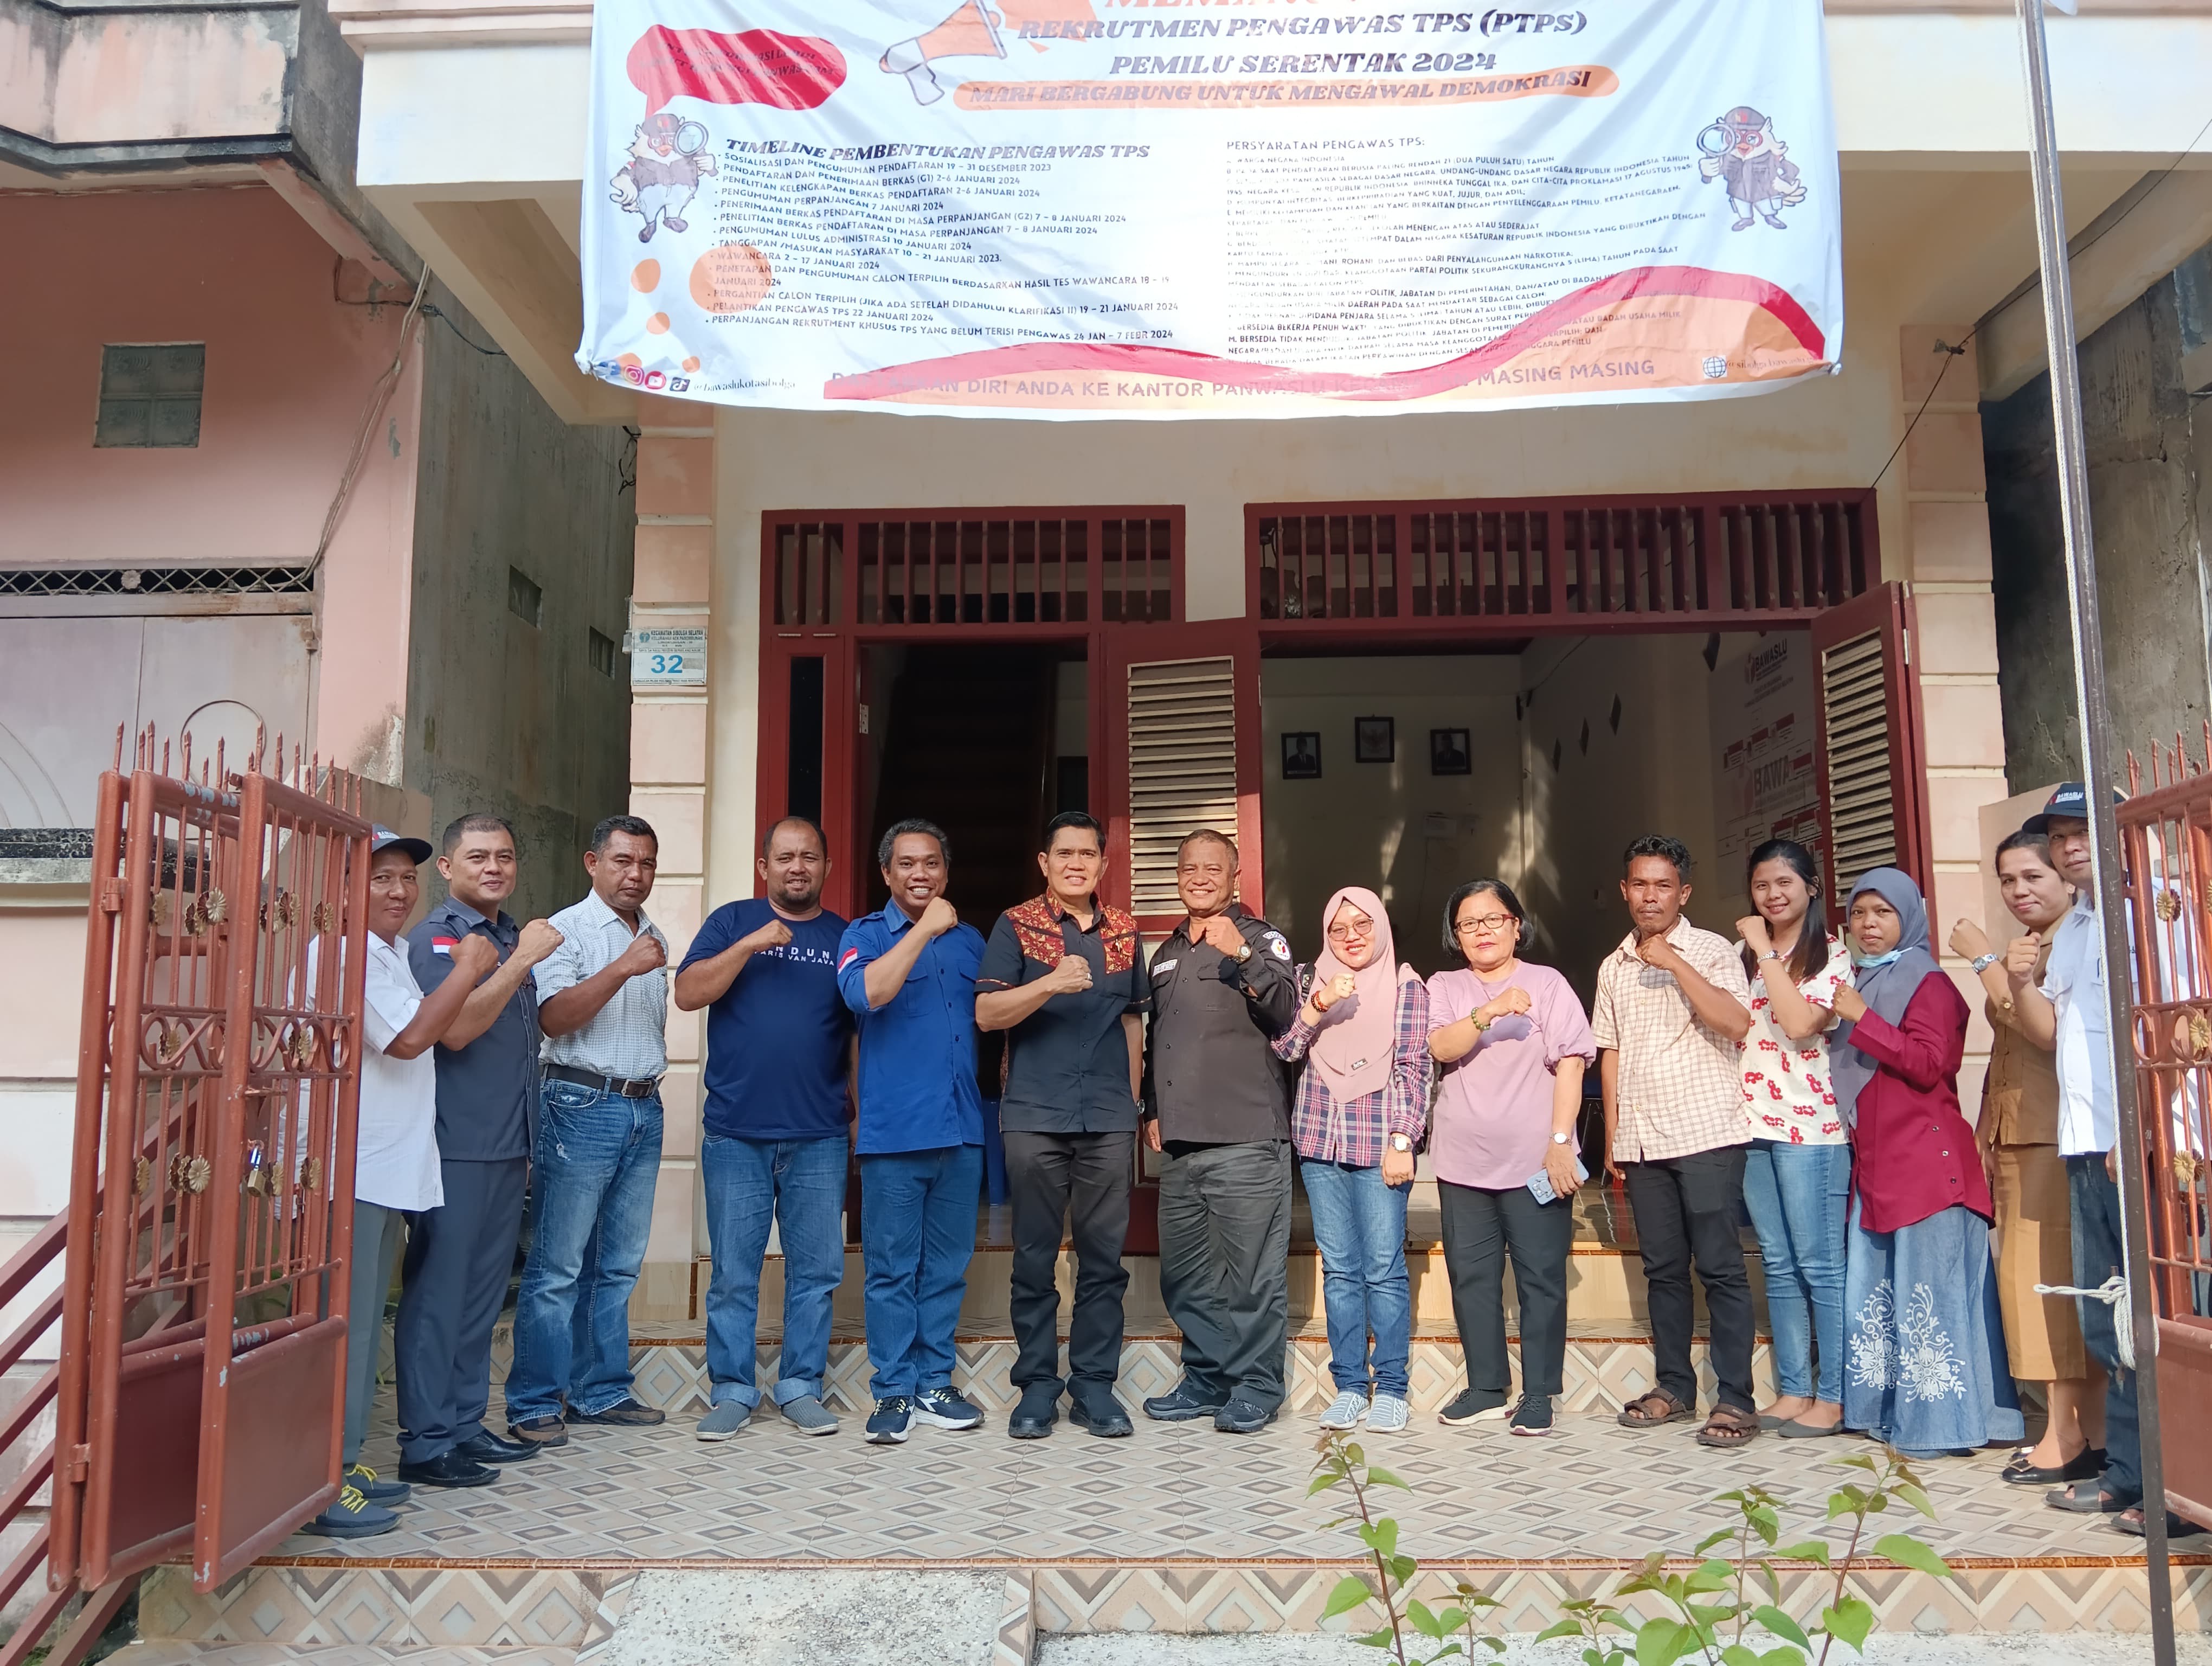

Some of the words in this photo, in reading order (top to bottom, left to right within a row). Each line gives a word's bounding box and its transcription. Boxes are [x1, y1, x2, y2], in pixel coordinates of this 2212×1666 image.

[1018, 18, 1222, 40] REKRUTMEN
[1226, 13, 1405, 37] PENGAWAS
[1412, 12, 1474, 33] TPS
[1480, 8, 1587, 37] (PTPS)
[1110, 55, 1233, 74] PEMILU
[1239, 52, 1409, 74] SERENTAK
[1412, 52, 1497, 73] 2024
[970, 86, 1038, 103] MARI
[1039, 85, 1193, 102] BERGABUNG
[1197, 85, 1285, 101] UNTUK
[1289, 83, 1435, 101] MENGAWAL
[1438, 69, 1592, 98] DEMOKRASI
[726, 139, 826, 158] TIMELINE
[829, 144, 986, 161] PEMBENTUKAN
[988, 145, 1105, 158] PENGAWAS
[1111, 145, 1150, 157] TPS
[1227, 141, 1317, 150] PERSYARATAN
[1323, 139, 1394, 149] PENGAWAS
[1399, 137, 1425, 146] TPS:
[725, 153, 781, 166] SOSIALISASI
[808, 159, 875, 174] PENGUMUMAN
[878, 162, 943, 172] PENDAFTARAN
[1544, 165, 1573, 174] NEGARA
[1614, 158, 1659, 173] INDONESIA
[724, 164, 792, 179] PENDAFTARAN
[819, 172, 879, 186] PENERIMAAN
[883, 175, 915, 186] BERKAS
[917, 175, 933, 184] (G1)
[955, 175, 995, 183] JANUARI
[1571, 176, 1622, 185] PROKLAMASI
[1635, 167, 1671, 177] AGUSTUS
[723, 176, 776, 190] PENELITIAN
[780, 183, 846, 193] KELENGKAPAN
[850, 189, 884, 198] BERKAS
[888, 188, 953, 199] PENDAFTARAN
[722, 188, 790, 203] PENGUMUMAN
[795, 196, 869, 208] PERPANJANGAN
[880, 203, 919, 212] JANUARI
[923, 202, 943, 211] 2024
[721, 201, 782, 214] PENERIMAAN
[786, 209, 821, 217] BERKAS
[824, 209, 891, 222] PENDAFTARAN
[909, 216, 934, 225] MASA
[937, 213, 1011, 223] PERPANJANGAN
[721, 213, 773, 224] PENELITIAN
[777, 219, 813, 229] BERKAS
[816, 222, 884, 231] PENDAFTARAN
[900, 228, 926, 237] MASA
[930, 226, 1003, 238] PERPANJANGAN
[1461, 232, 1503, 241] KESATURAN
[1506, 232, 1543, 241] REPUBLIK
[1546, 229, 1591, 238] INDONESIA
[1619, 214, 1669, 230] DIBUKTIKAN
[719, 227, 788, 237] PENGUMUMAN
[792, 232, 820, 242] LULUS
[824, 234, 890, 244] ADMINISTRASI
[906, 241, 946, 249] JANUARI
[950, 242, 971, 250] 2024
[719, 239, 777, 247] TANGGAPAN
[780, 243, 832, 254] /MASUKAN
[835, 248, 899, 256] MASYARAKAT
[979, 254, 1001, 262] 2023.
[1447, 254, 1521, 264] PENYALAHGUNAAN
[1603, 251, 1630, 262] TAHUN
[1634, 247, 1656, 255] PADA
[814, 258, 854, 268] JANUARI
[799, 268, 869, 281] PENGUMUMAN
[872, 274, 905, 282] CALON
[909, 274, 949, 283] TERPILIH
[953, 278, 1021, 289] BERDASARKAN
[1025, 279, 1051, 288] HASIL
[1072, 277, 1137, 285] WAWANCARA
[775, 305, 828, 313] PENGAWAS
[832, 307, 849, 316] TPS
[866, 310, 908, 321] JANUARI
[815, 293, 857, 304] TERPILIH
[859, 298, 883, 307] (JIKA
[911, 300, 949, 309] SETELAH
[953, 300, 1005, 312] DIDAHULUI
[1009, 303, 1064, 315] KLARIFIKASI
[1112, 303, 1153, 312] JANUARI
[712, 315, 789, 325] PERPANJANGAN
[793, 318, 856, 328] REKRUTMENT
[859, 322, 897, 331] KHUSUS
[901, 325, 916, 334] TPS
[921, 326, 947, 334] YANG
[951, 327, 982, 336] BELUM
[986, 327, 1014, 335] TERISI
[1018, 329, 1070, 339] PENGAWAS
[1088, 332, 1105, 340] JAN
[1151, 330, 1173, 338] 2024
[968, 380, 1007, 394] DIRI
[1015, 381, 1074, 396] ANDA
[1083, 382, 1110, 396] KE
[1117, 383, 1203, 396] KANTOR
[1478, 366, 1561, 385] MASING
[1571, 360, 1655, 379] MASING
[651, 655, 683, 674] 32
[1756, 638, 1787, 671] BAWASLU
[776, 946, 829, 959] NDUN
[812, 957, 834, 966] JAVA
